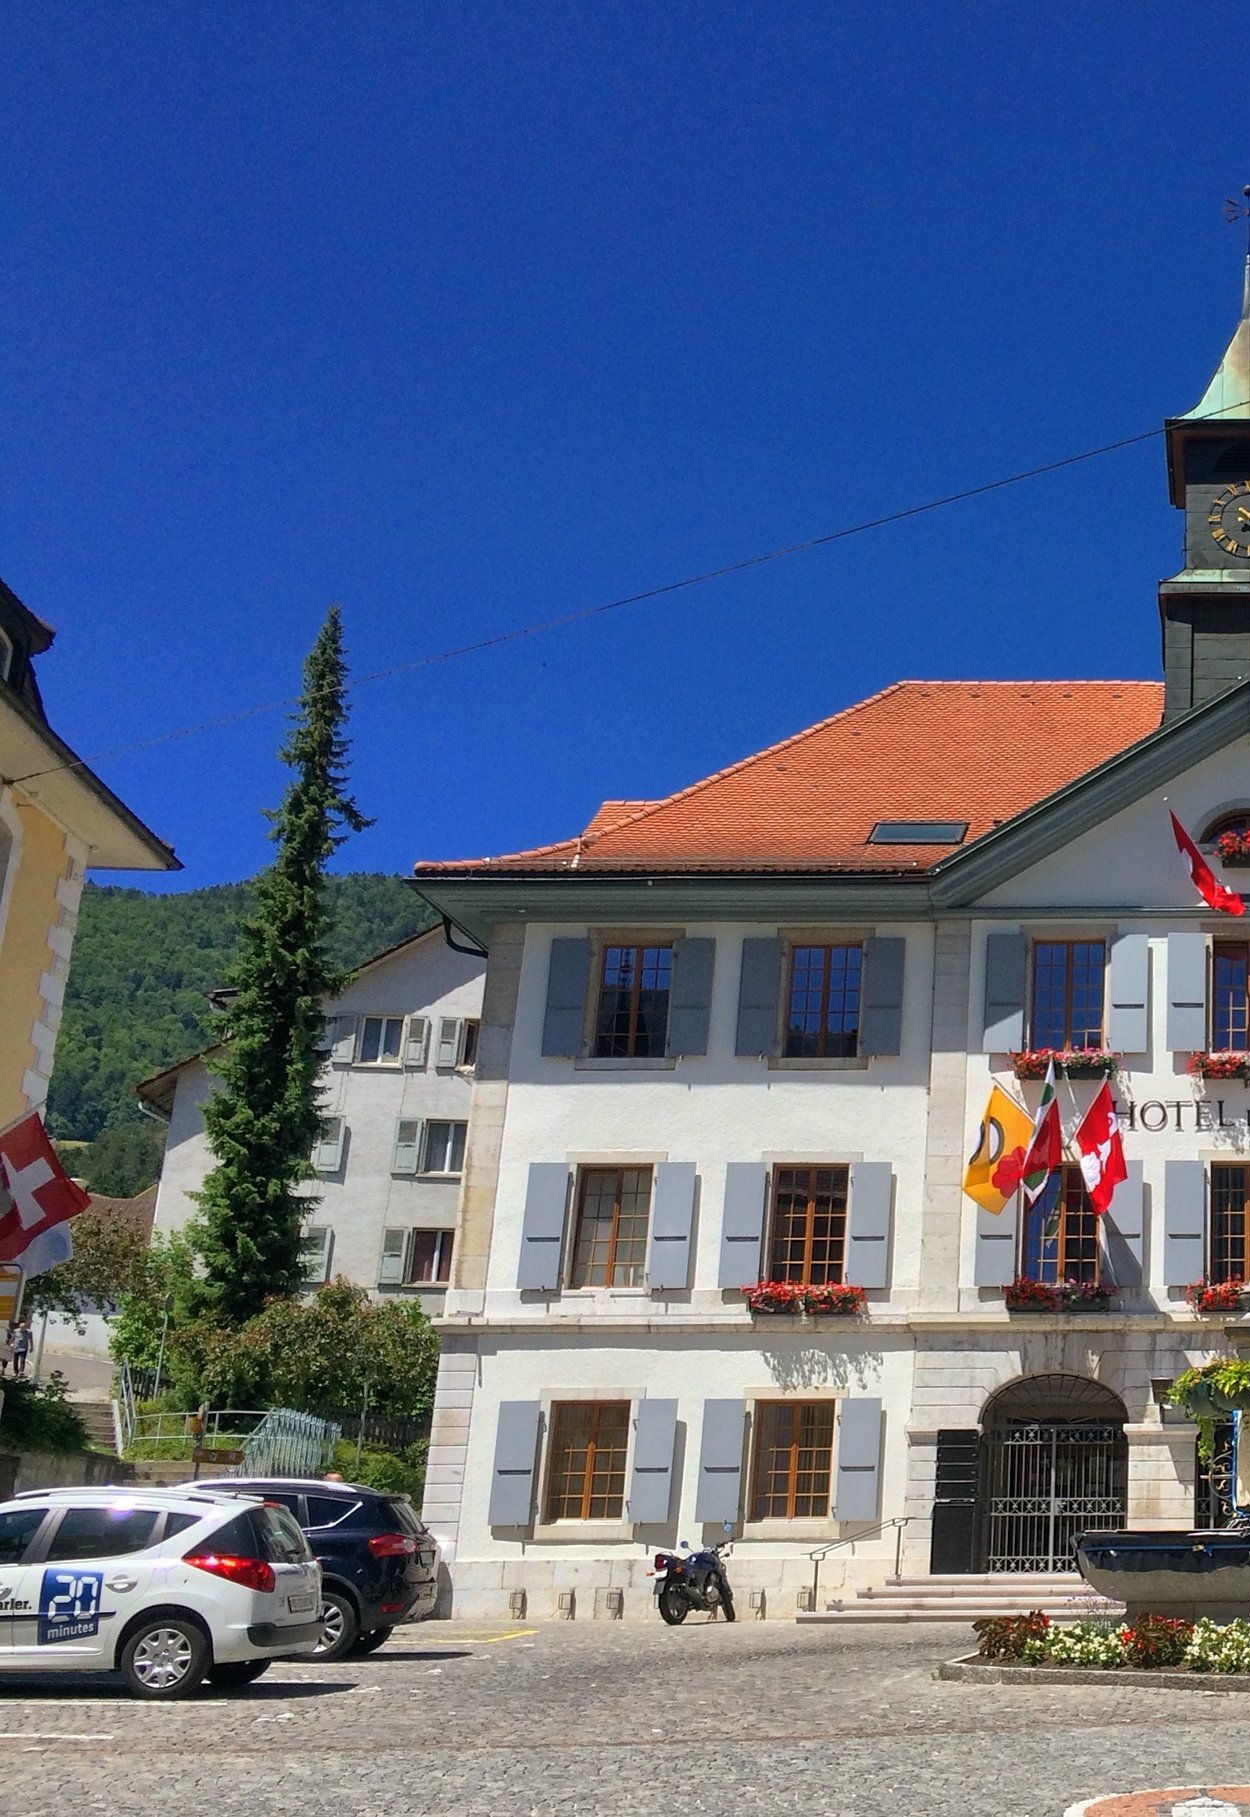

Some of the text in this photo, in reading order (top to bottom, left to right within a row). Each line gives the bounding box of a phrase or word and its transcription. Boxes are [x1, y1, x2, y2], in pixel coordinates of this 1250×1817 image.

[1112, 1100, 1235, 1128] HOTEL
[47, 1575, 99, 1623] 20
[47, 1623, 94, 1640] minutes
